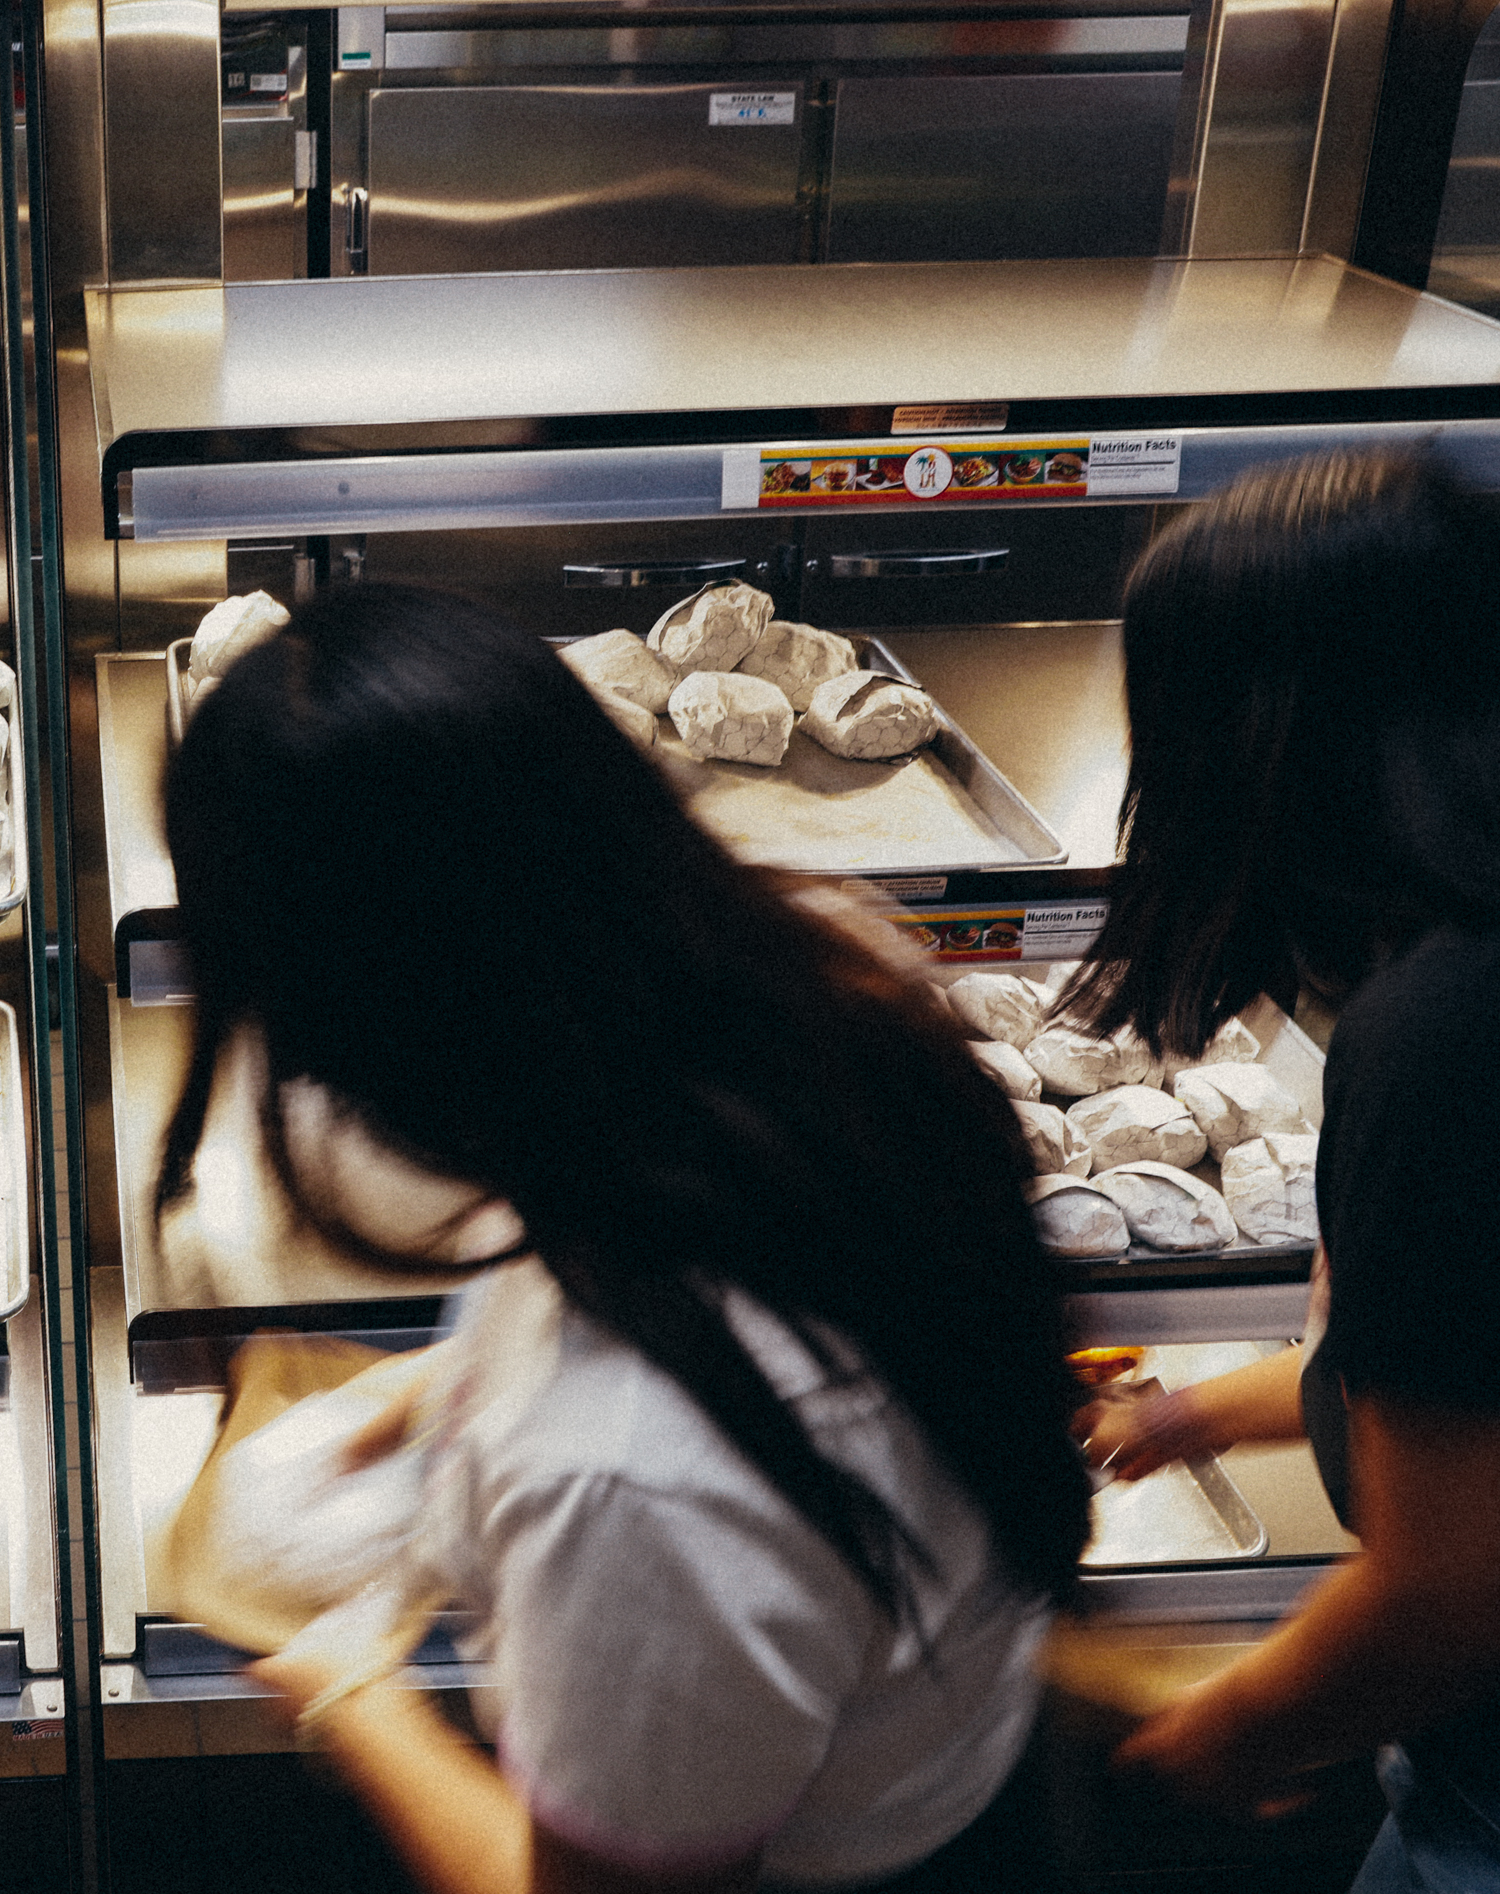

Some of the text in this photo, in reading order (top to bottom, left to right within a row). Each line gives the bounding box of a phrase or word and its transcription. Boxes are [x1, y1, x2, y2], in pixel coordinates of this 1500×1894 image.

[1091, 438, 1177, 454] Nutrition Facts
[1026, 908, 1105, 923] Nutrition Facts
